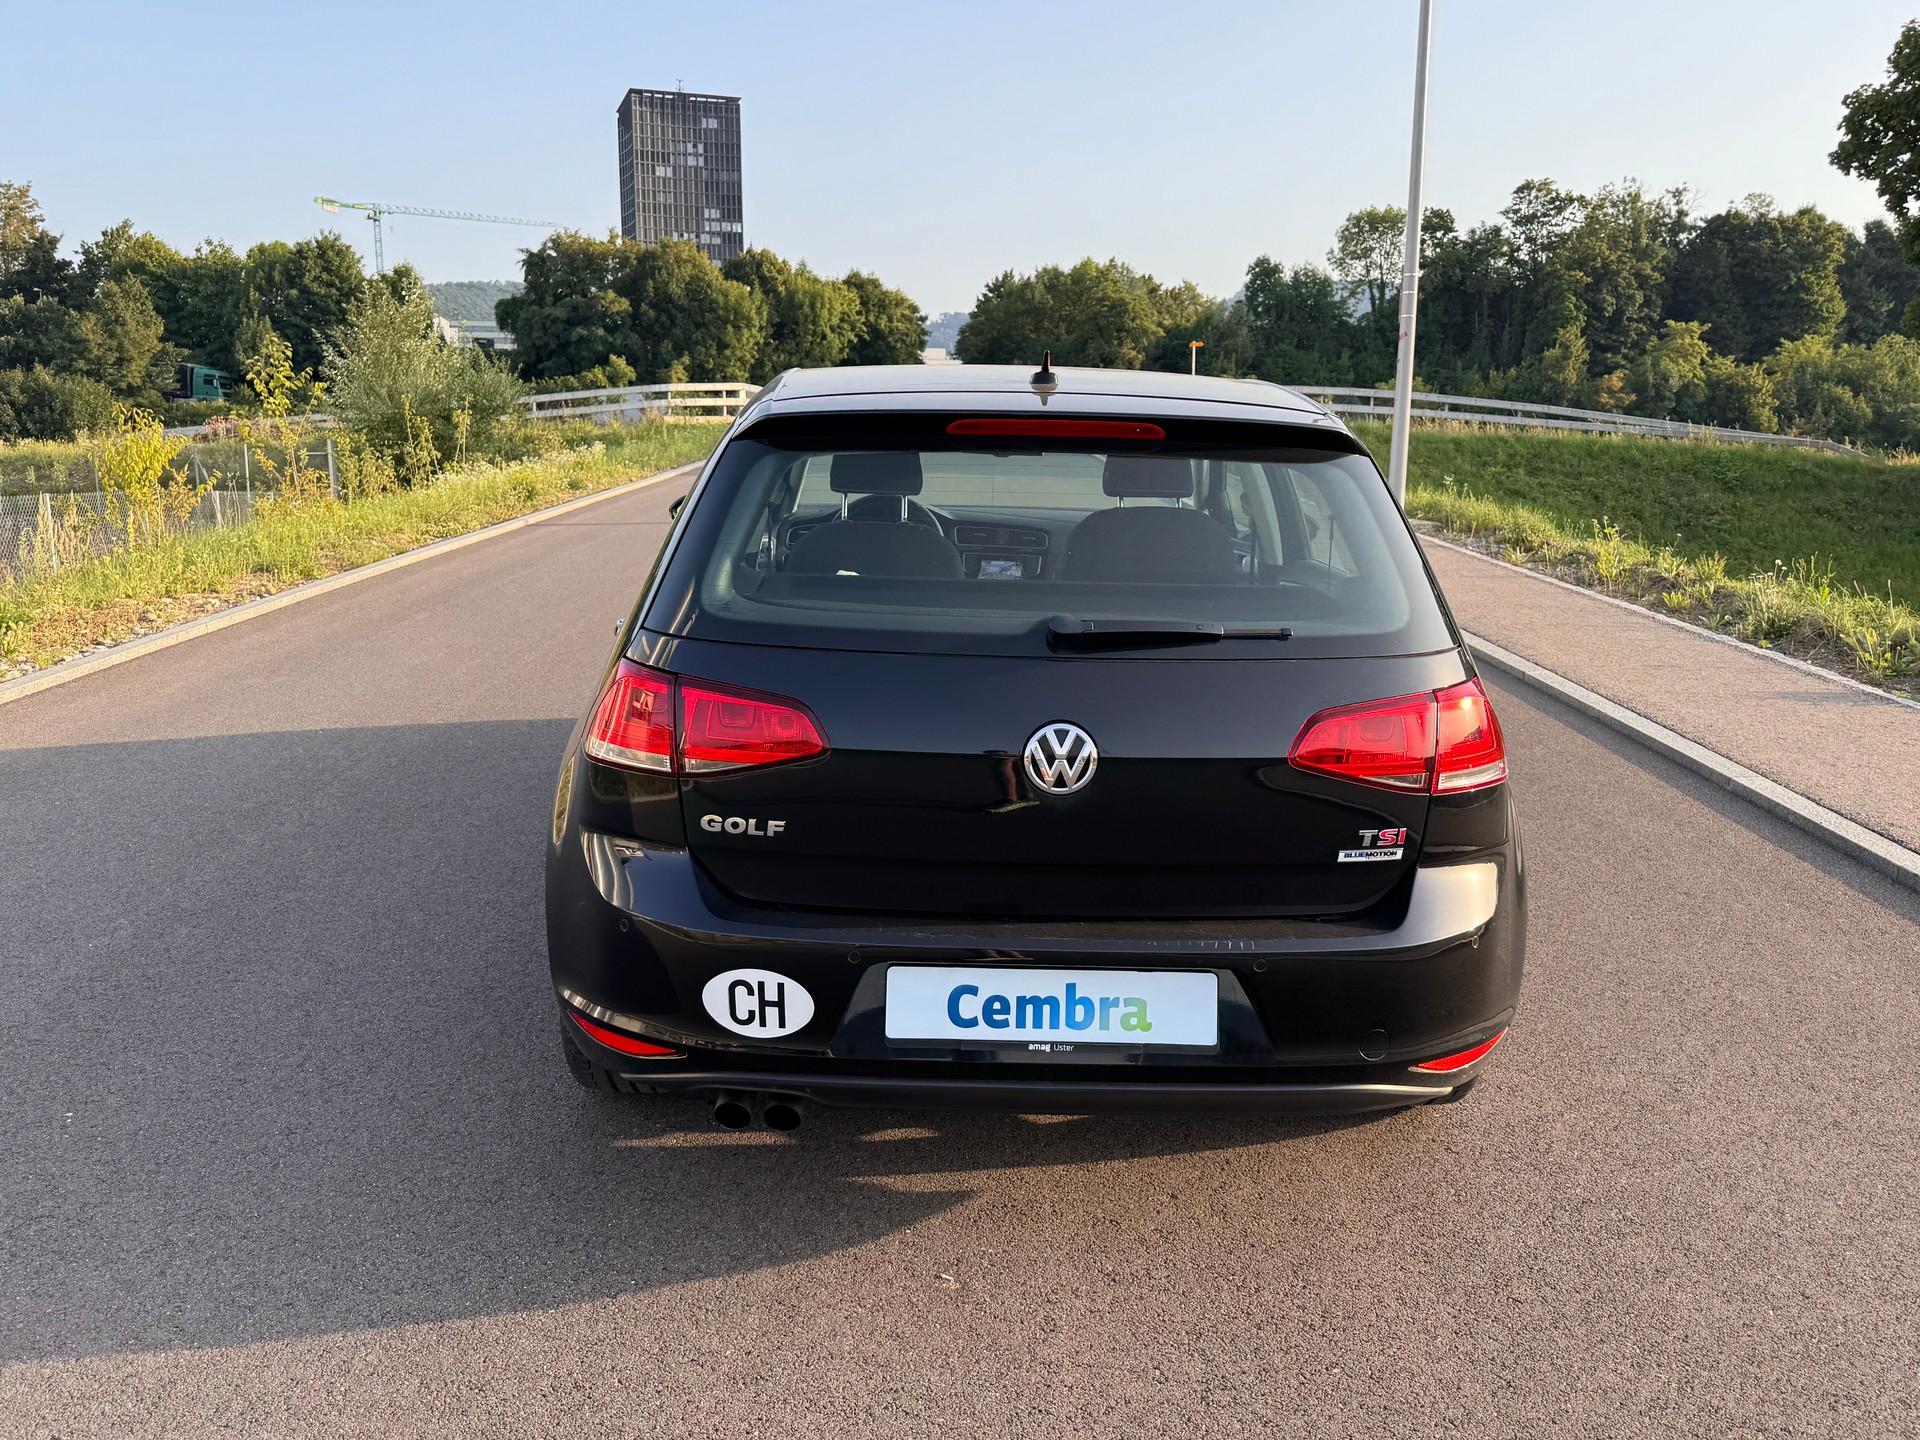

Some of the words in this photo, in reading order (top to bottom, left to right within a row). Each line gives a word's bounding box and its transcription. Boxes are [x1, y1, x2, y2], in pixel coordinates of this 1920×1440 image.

[700, 814, 786, 837] GOLF
[1359, 827, 1408, 847] TSI
[728, 979, 786, 1029] CH
[947, 982, 1153, 1032] Cembra
[1028, 1043, 1051, 1052] amag
[1053, 1043, 1075, 1051] Uster
